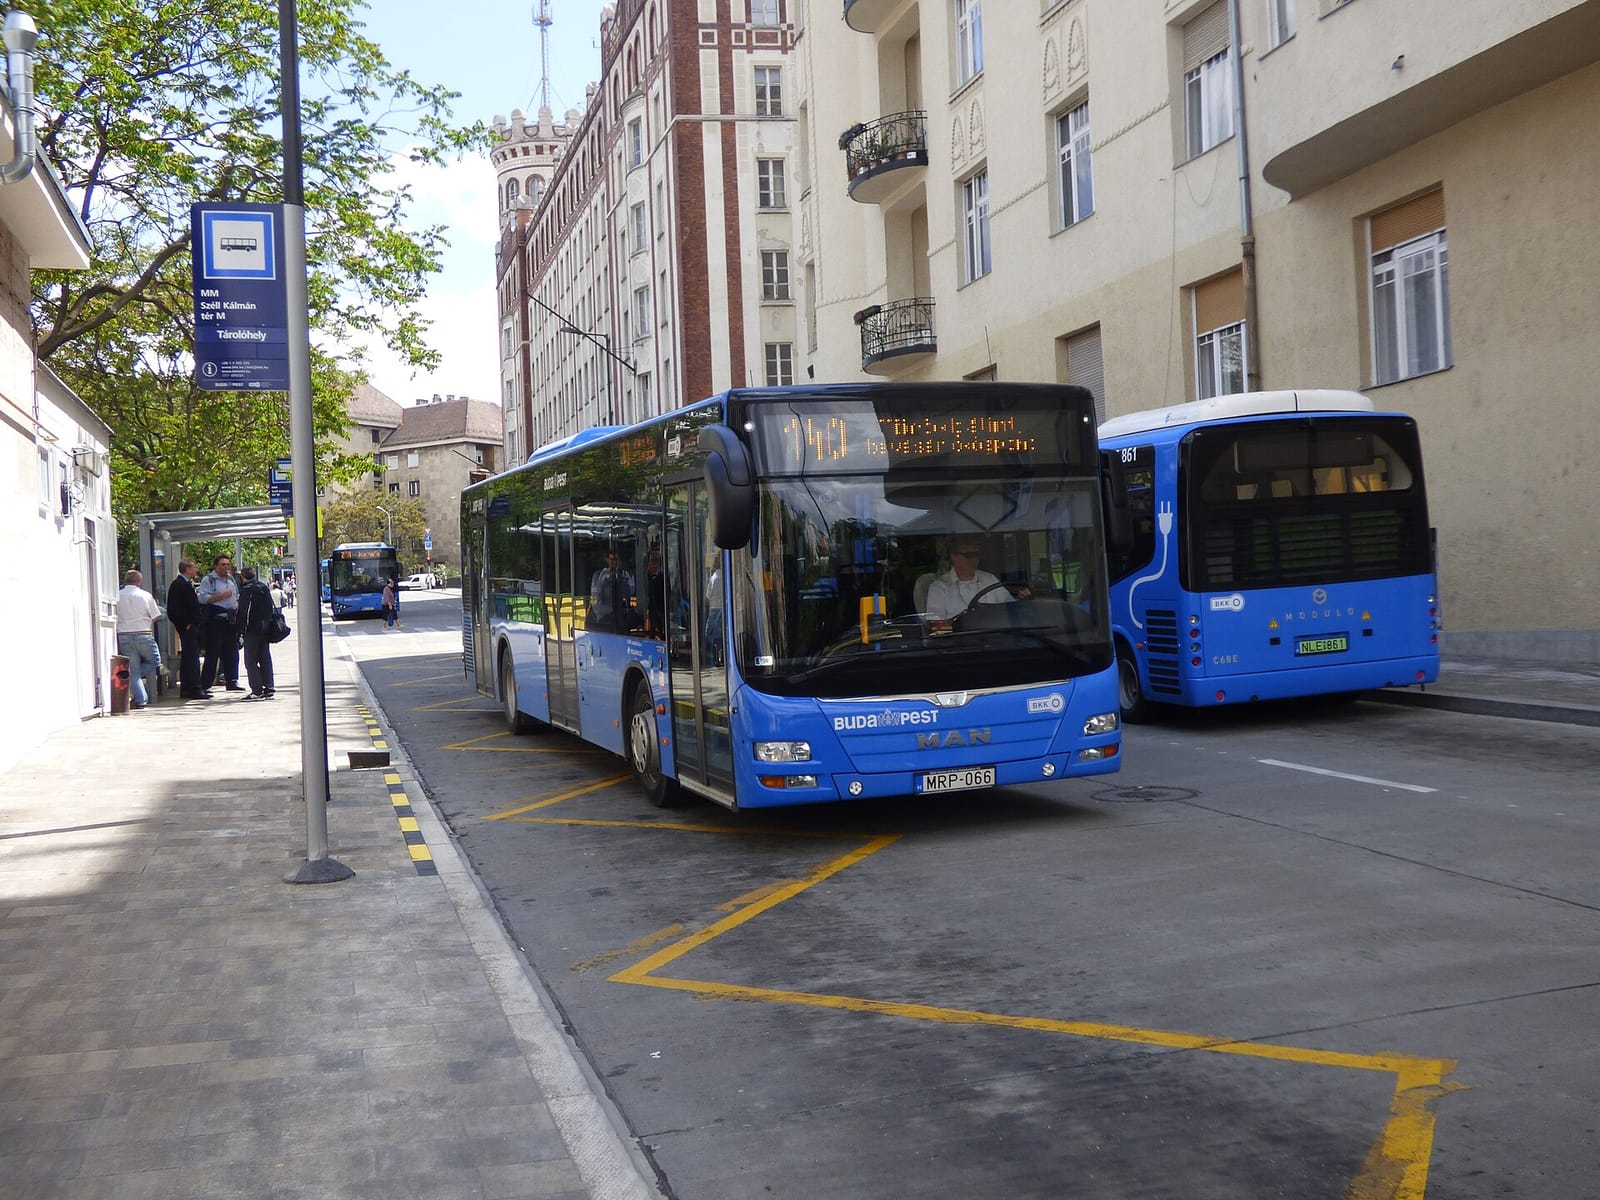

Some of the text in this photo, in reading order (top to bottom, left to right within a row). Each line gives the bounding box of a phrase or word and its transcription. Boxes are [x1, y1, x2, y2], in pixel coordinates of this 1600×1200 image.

[201, 289, 219, 297] MM
[200, 301, 257, 310] Széll Kálmán
[201, 312, 226, 320] tér M
[216, 330, 267, 342] Tárolóhely
[1121, 446, 1137, 463] 861
[1286, 607, 1354, 621] MODULO
[1032, 701, 1049, 709] BKK
[916, 728, 992, 751] MAN
[926, 770, 992, 790] MRP-066
